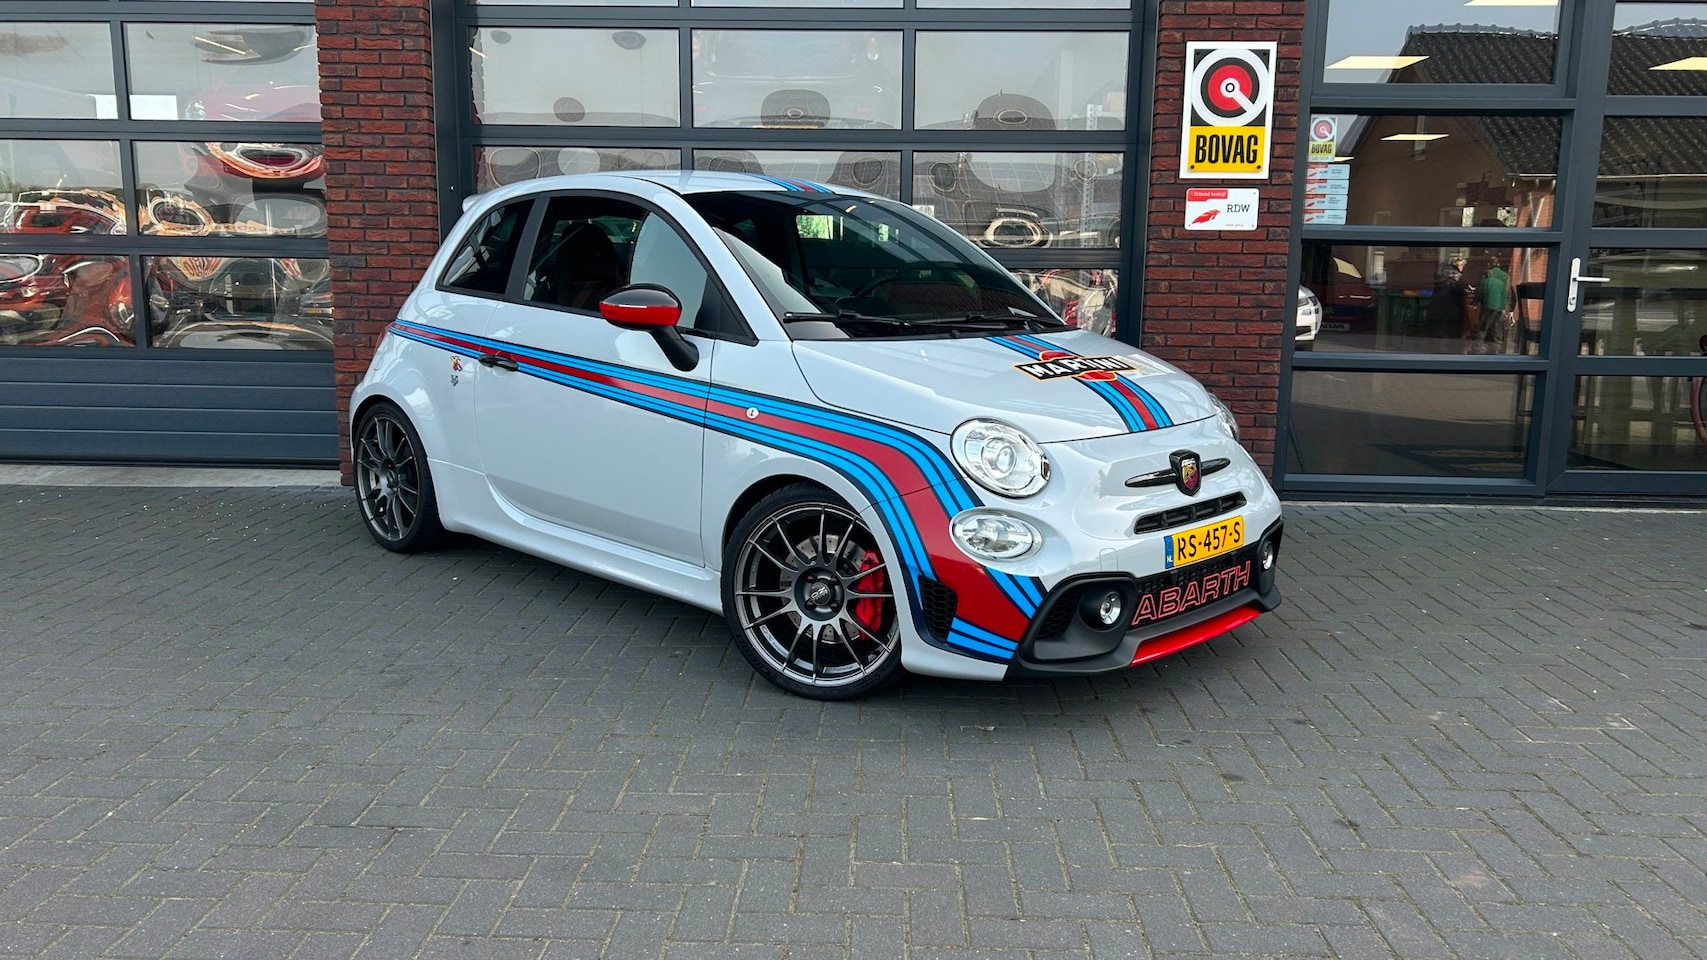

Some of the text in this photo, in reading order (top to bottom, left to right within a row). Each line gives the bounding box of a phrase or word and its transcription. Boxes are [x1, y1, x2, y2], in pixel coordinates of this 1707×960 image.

[1194, 134, 1259, 164] BOVAG
[1311, 143, 1332, 154] BOVAG
[1226, 204, 1251, 213] RDW
[1021, 357, 1129, 377] MARTINI
[1177, 521, 1241, 561] RS-457-S
[1131, 560, 1251, 626] ABARTH
